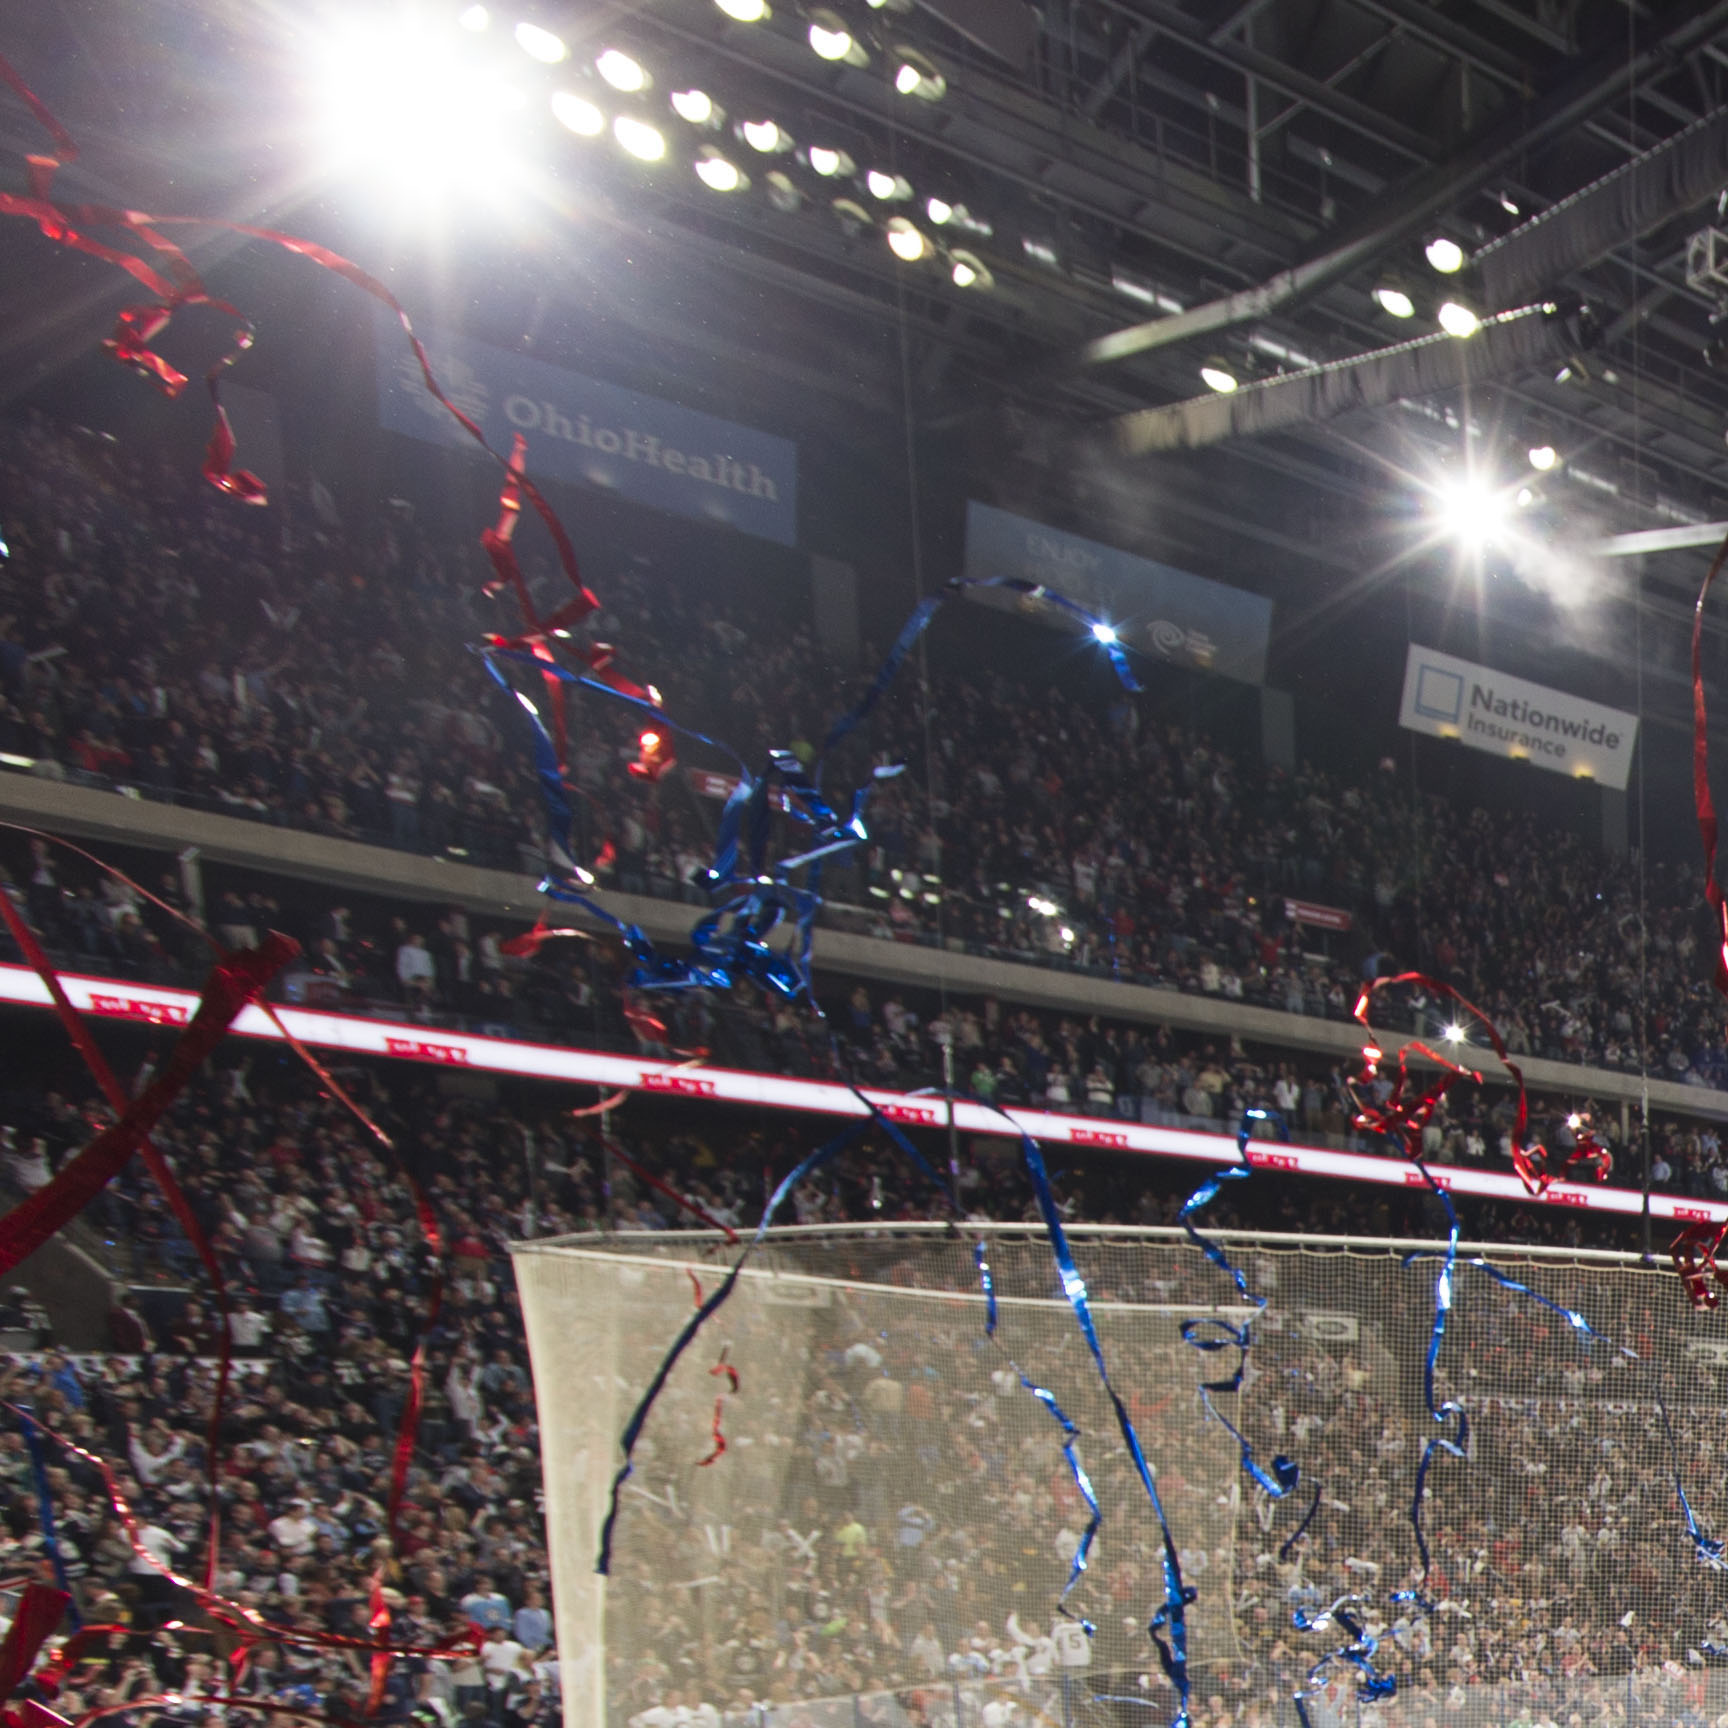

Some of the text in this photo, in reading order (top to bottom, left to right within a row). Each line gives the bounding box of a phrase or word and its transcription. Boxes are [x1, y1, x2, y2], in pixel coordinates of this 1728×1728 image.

[504, 395, 778, 500] OhioHealth
[1467, 713, 1566, 759] Insurance
[1471, 684, 1620, 750] Nationwide
